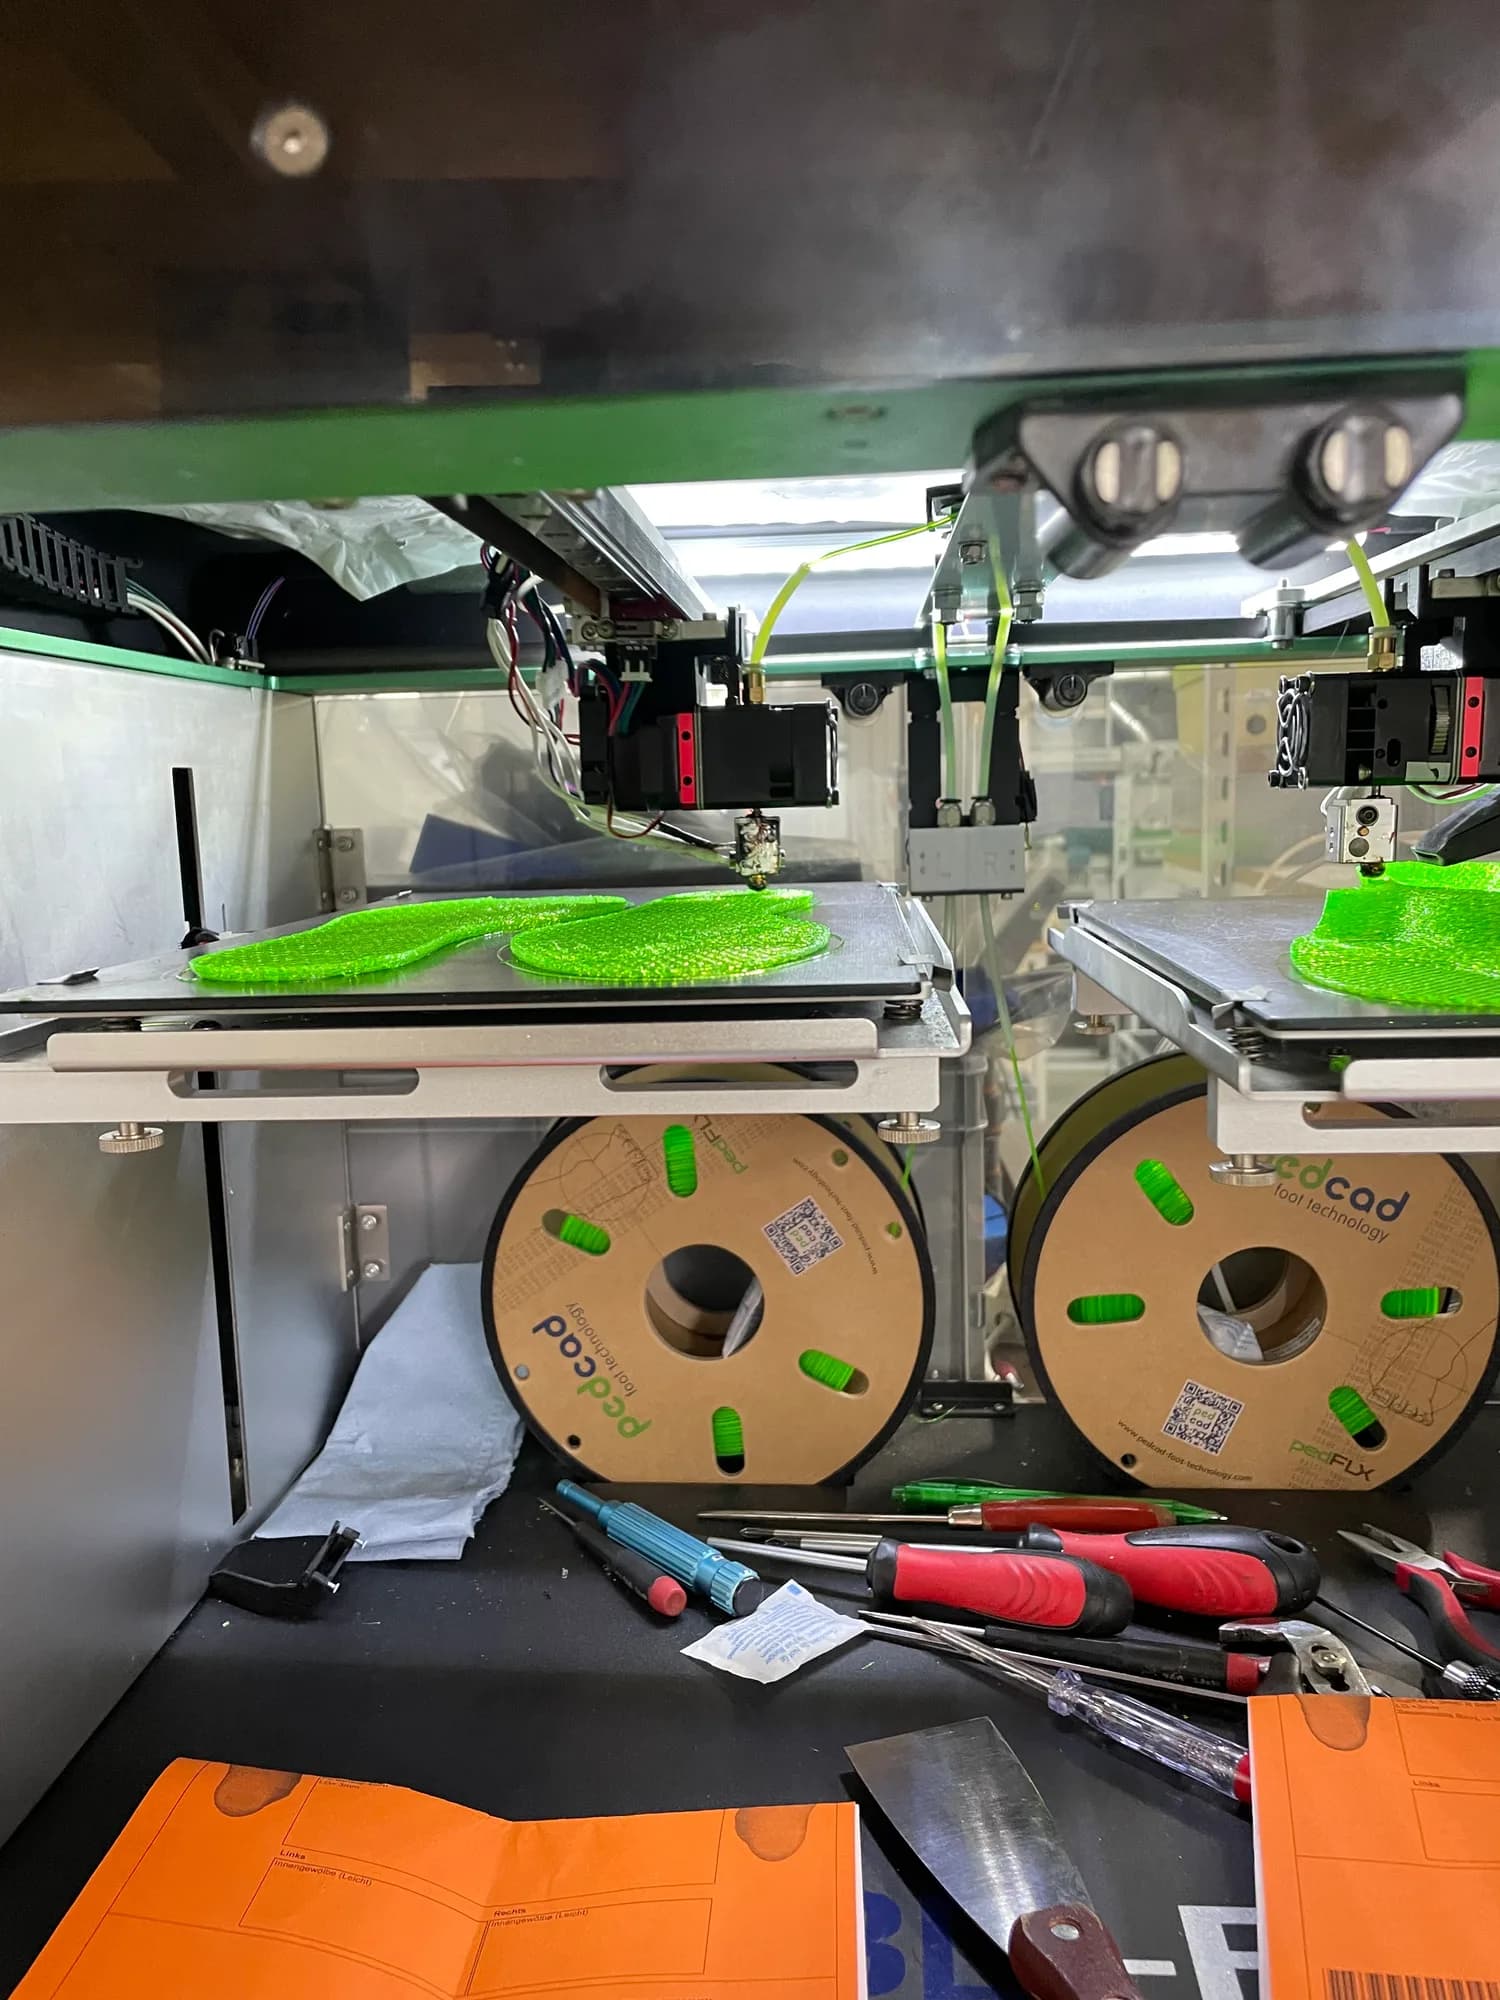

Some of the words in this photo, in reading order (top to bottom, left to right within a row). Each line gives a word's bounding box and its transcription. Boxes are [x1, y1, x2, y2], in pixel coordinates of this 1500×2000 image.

[1269, 1155, 1410, 1222] edcad
[1273, 1183, 1302, 1205] foot
[1306, 1198, 1391, 1244] technology
[565, 1301, 619, 1371] technology
[532, 1314, 653, 1438] pedcad
[613, 1370, 639, 1397] foot
[1117, 1418, 1253, 1482] www.pedcad-foot-technology.com
[1288, 1439, 1376, 1482] pedFLX
[279, 1849, 306, 1860] Links
[337, 1871, 373, 1887] (Leicht)
[493, 1908, 527, 1917] Rechts
[554, 1908, 589, 1921] (Leicht)
